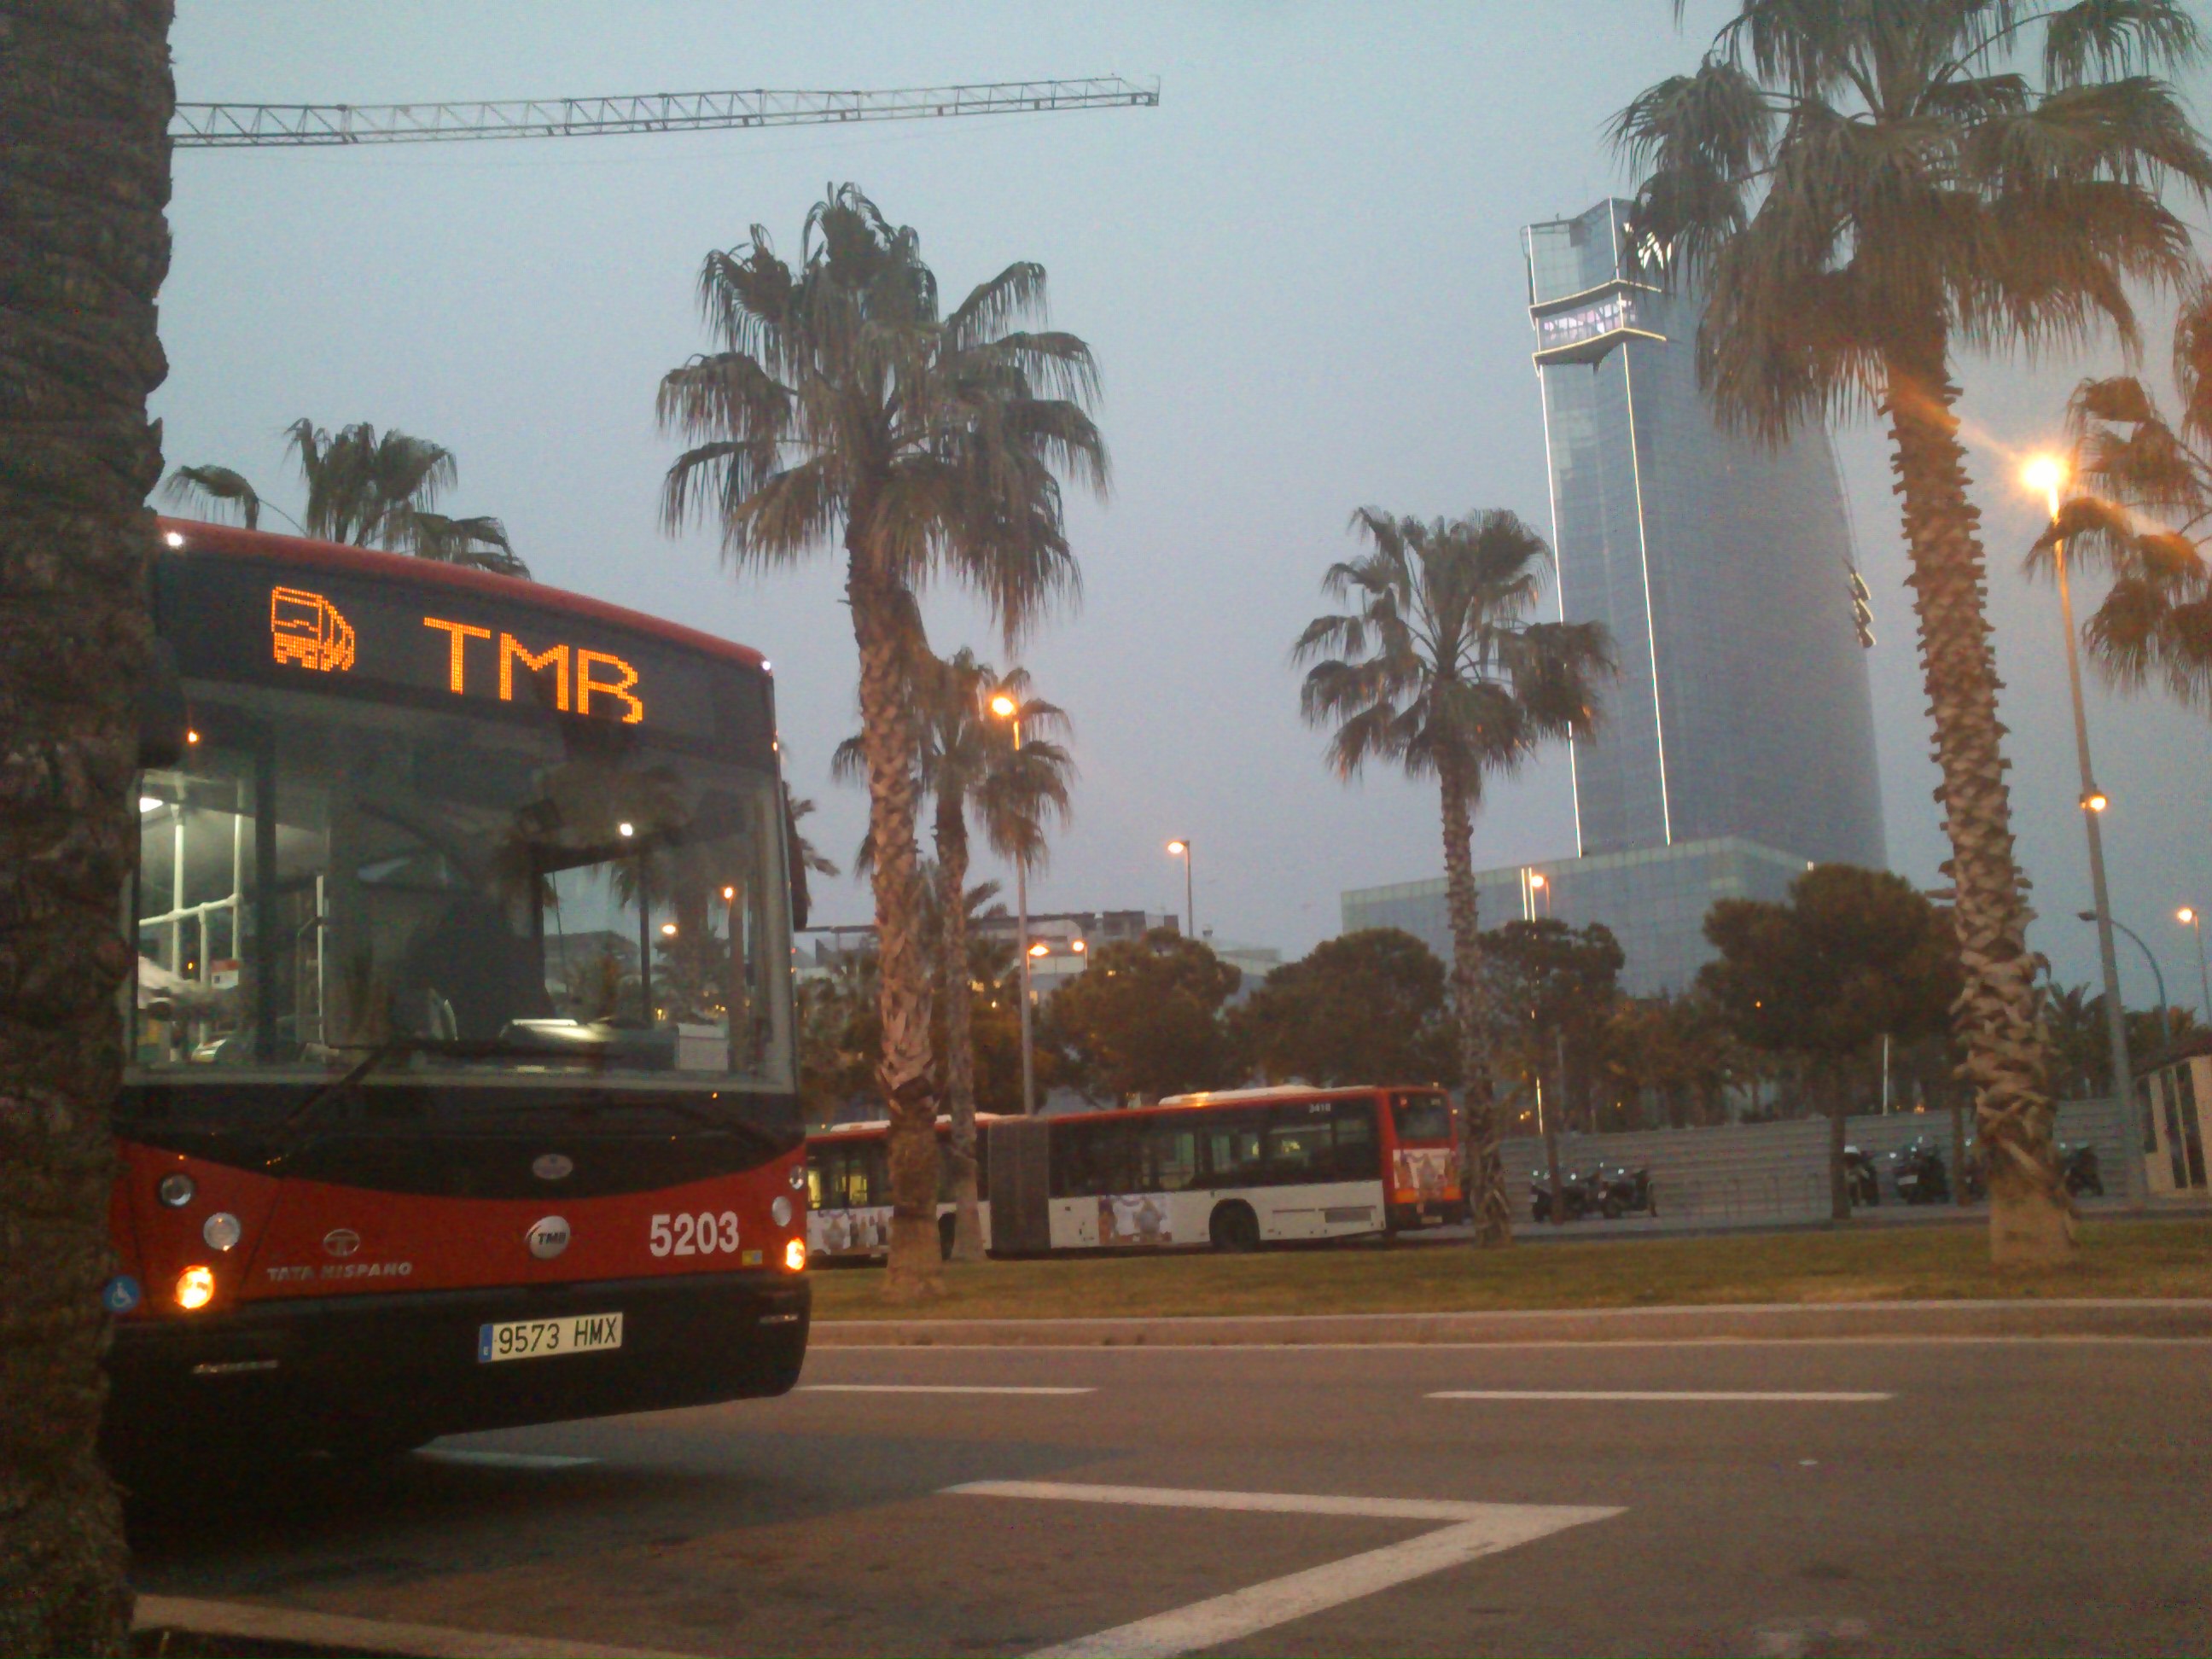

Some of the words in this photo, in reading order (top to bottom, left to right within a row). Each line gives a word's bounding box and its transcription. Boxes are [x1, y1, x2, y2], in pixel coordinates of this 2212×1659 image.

[649, 1210, 739, 1257] 5203
[266, 1266, 315, 1282] TATA
[321, 1261, 412, 1280] HISPANO
[498, 1323, 560, 1355] 9573
[573, 1316, 617, 1347] HMX
